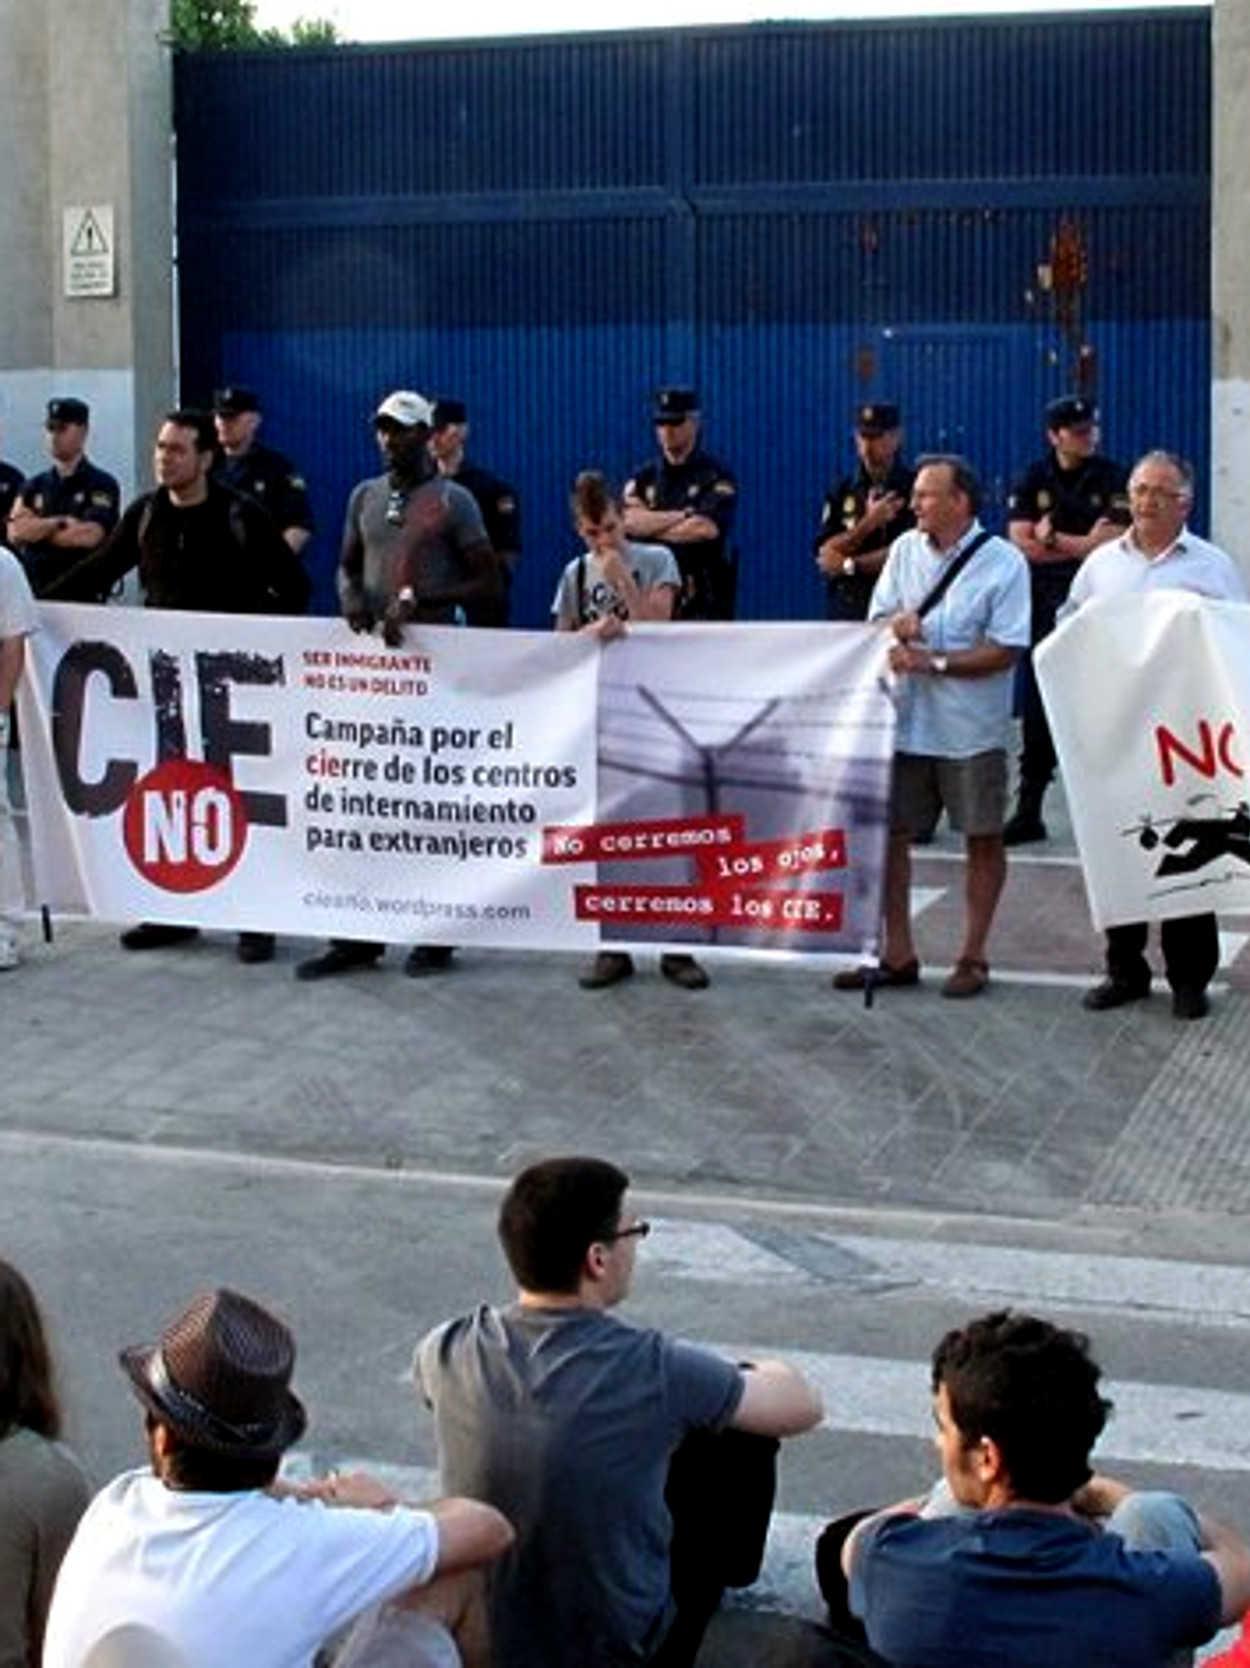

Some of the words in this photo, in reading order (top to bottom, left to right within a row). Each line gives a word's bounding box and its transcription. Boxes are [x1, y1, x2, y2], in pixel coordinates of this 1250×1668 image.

[302, 651, 332, 667] SER
[335, 652, 432, 674] INMIGRANTE
[303, 673, 325, 689] NO
[328, 674, 346, 691] ES
[349, 677, 368, 692] UN
[371, 677, 429, 696] DELITO
[52, 640, 288, 827] CIE
[305, 711, 424, 749] Campaña
[430, 726, 480, 754] por
[487, 721, 513, 749] el
[305, 748, 376, 780] cierre
[384, 755, 416, 785] de
[423, 756, 466, 785] los
[472, 763, 577, 788] centros
[305, 783, 334, 812] de
[341, 786, 537, 824] internamiento
[143, 786, 233, 866] NO
[306, 825, 362, 852] para
[369, 830, 529, 861] extranjeros
[553, 834, 585, 856] No
[600, 825, 733, 853] cerremos
[717, 854, 765, 878] los
[585, 894, 714, 915] cerremos
[731, 894, 774, 918] los
